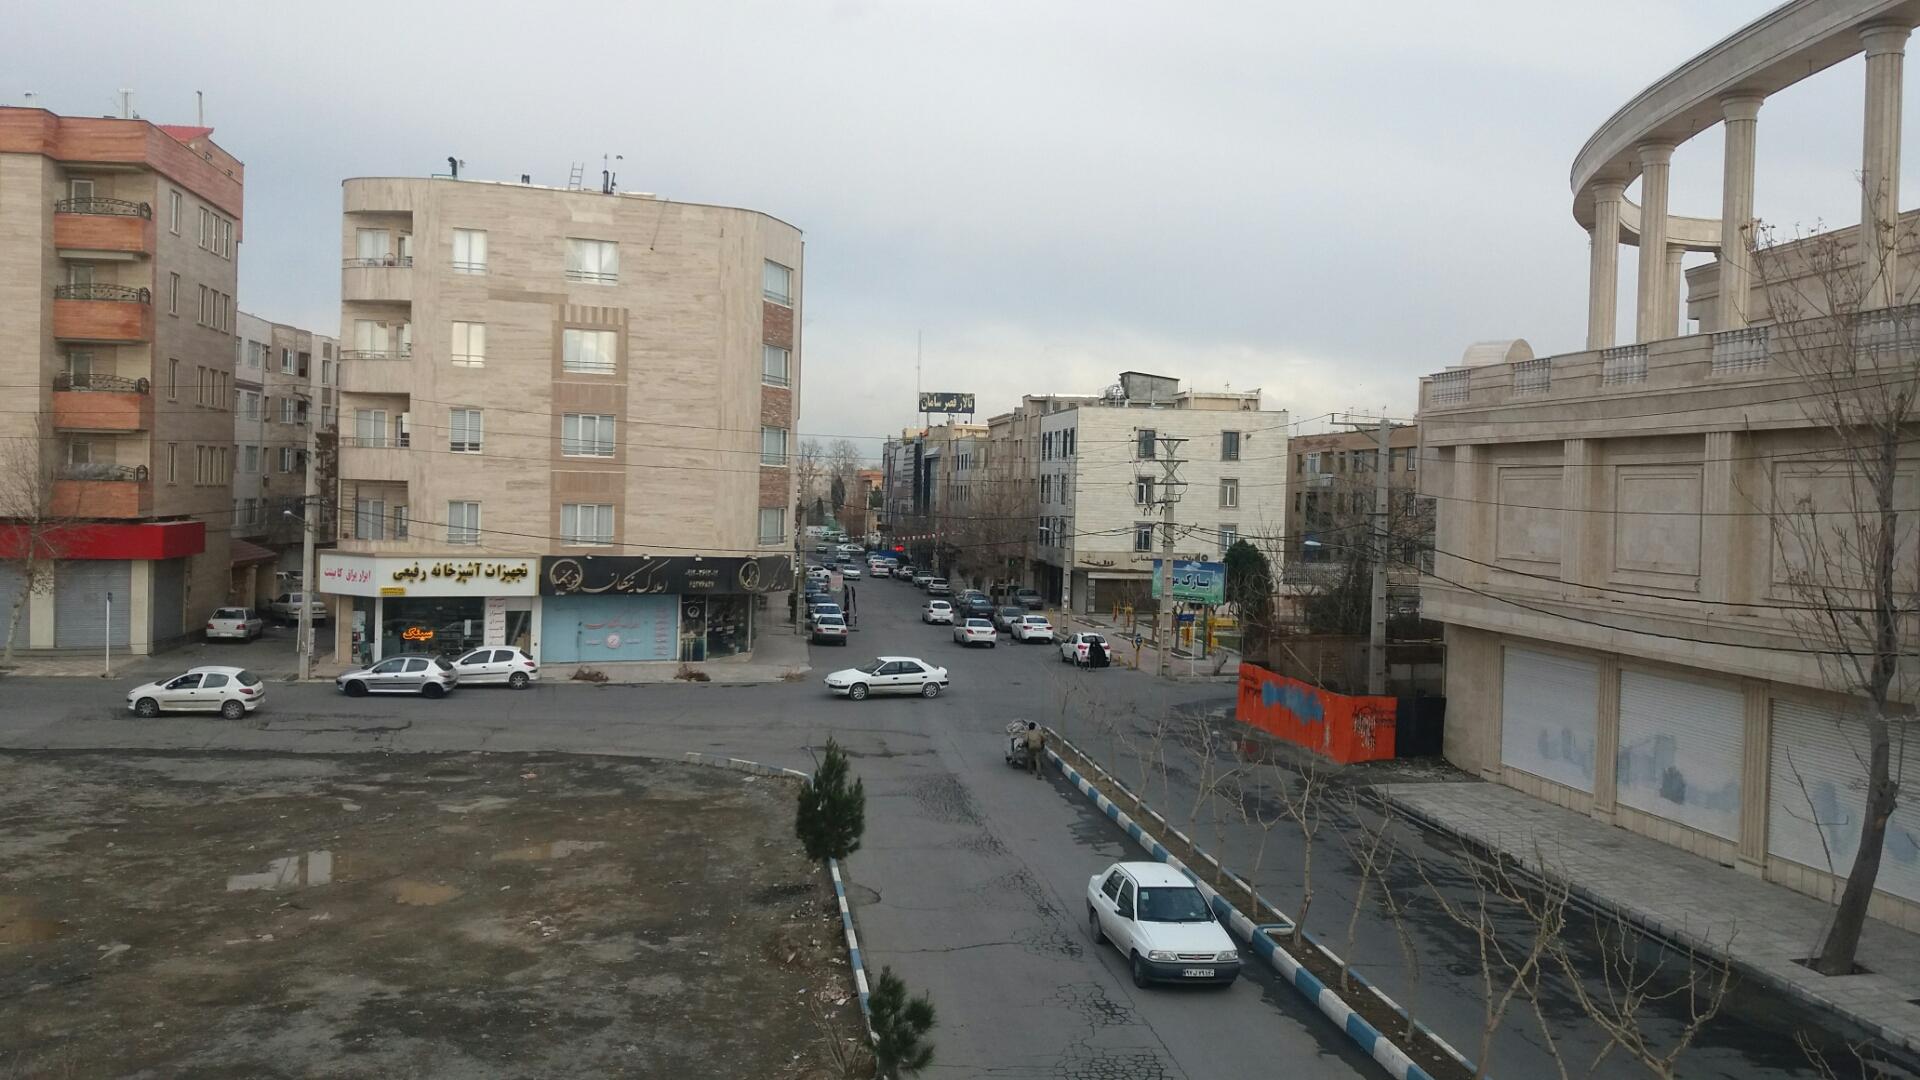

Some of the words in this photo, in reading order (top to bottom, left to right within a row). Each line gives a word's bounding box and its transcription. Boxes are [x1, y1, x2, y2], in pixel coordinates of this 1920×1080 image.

[920, 395, 942, 410] سامان
[943, 394, 957, 411] قصر
[958, 394, 973, 411] تالار
[392, 561, 427, 583] رفیعی
[431, 561, 482, 584] آشپزخانه
[484, 563, 528, 583] تجهیزات
[1182, 574, 1209, 590] پارک
